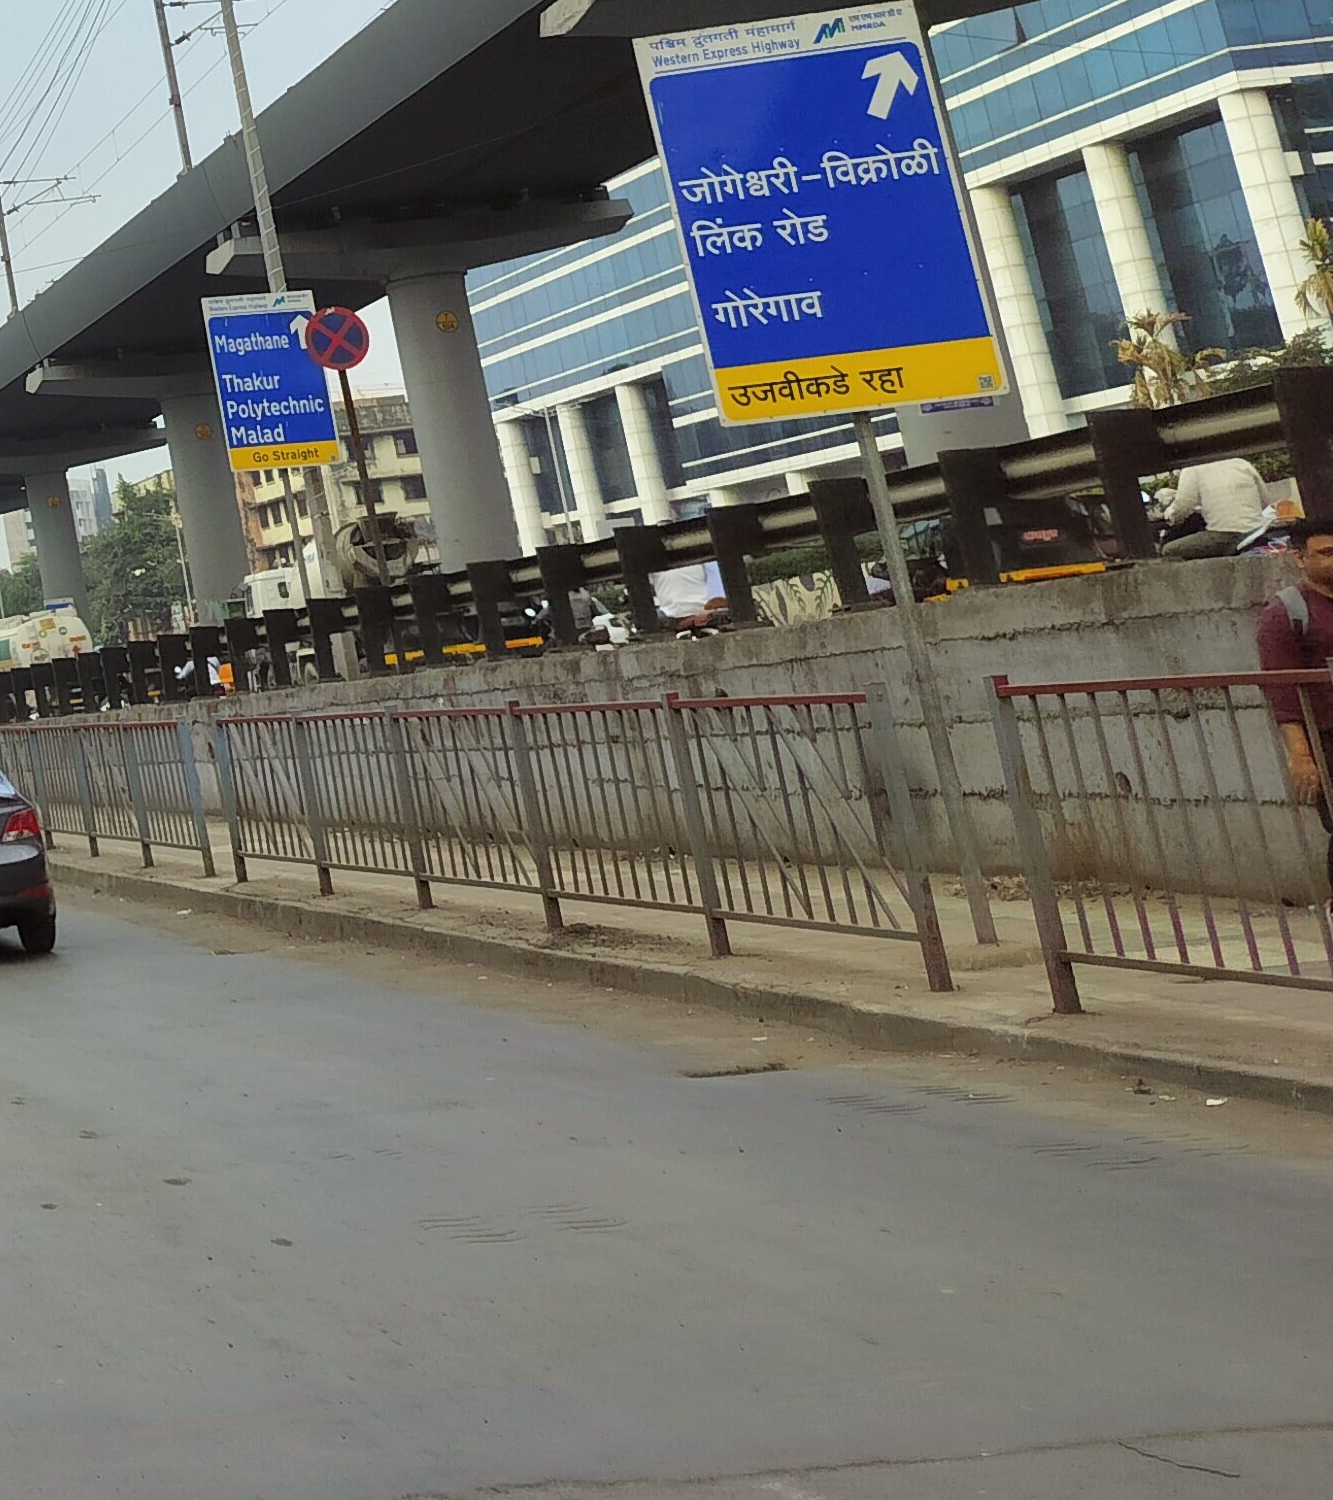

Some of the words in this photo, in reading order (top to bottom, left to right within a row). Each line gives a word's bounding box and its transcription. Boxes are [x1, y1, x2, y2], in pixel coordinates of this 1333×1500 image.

[651, 52, 699, 67] Western
[702, 45, 748, 61] Express
[751, 39, 800, 54] Highway
[690, 217, 763, 257] लिंक
[772, 207, 829, 246] रोड
[711, 287, 823, 329] गोरेगाव
[214, 332, 290, 355] Magathane
[222, 372, 280, 393] Thakur
[727, 365, 850, 407] उजवीकडे
[859, 366, 904, 394] रहा
[226, 395, 324, 421] Polytechnic
[231, 424, 285, 446] Malad
[252, 451, 269, 463] Go
[273, 447, 320, 462] Straight
